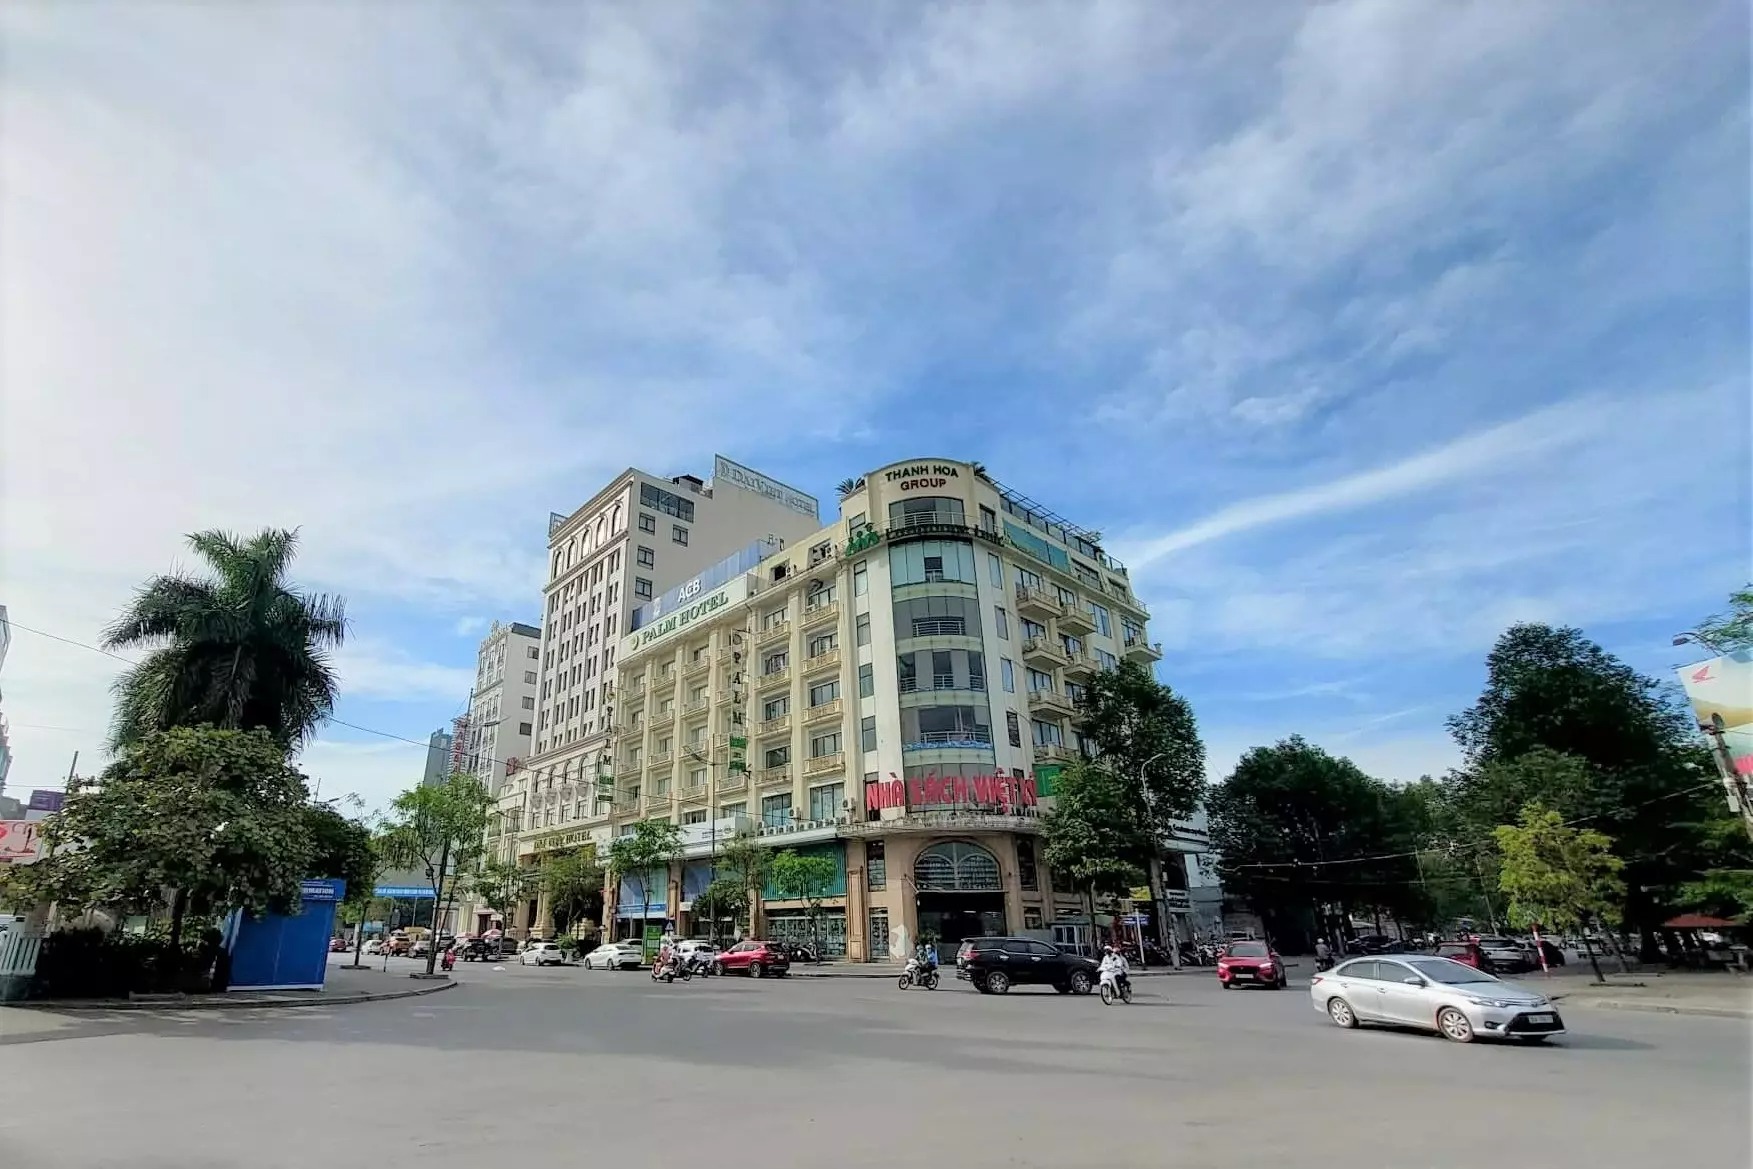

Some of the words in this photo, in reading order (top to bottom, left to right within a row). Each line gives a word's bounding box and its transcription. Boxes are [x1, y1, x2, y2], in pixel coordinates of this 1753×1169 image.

[885, 465, 929, 482] THANH
[933, 465, 959, 478] HOA
[900, 478, 947, 491] GROUP
[678, 580, 701, 602] ACB
[643, 616, 677, 645] PALM
[680, 591, 729, 626] HOTEL
[866, 772, 905, 811] NHÀ
